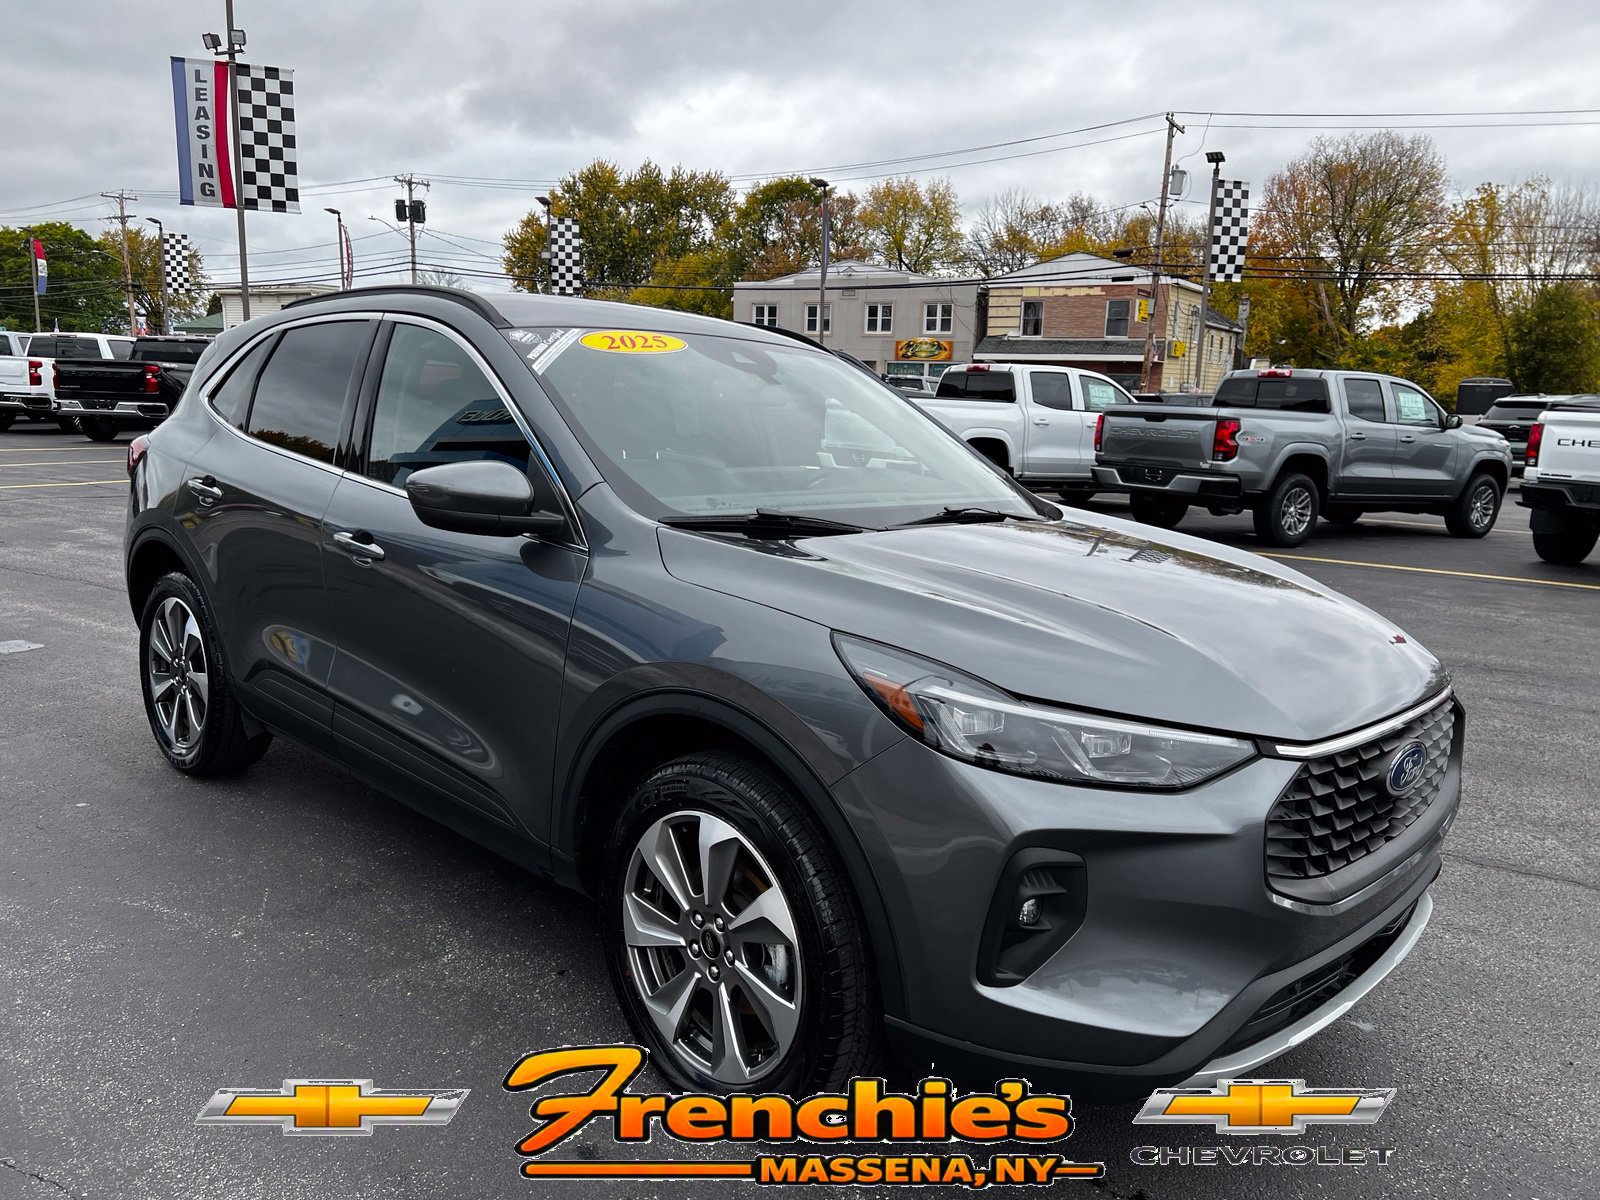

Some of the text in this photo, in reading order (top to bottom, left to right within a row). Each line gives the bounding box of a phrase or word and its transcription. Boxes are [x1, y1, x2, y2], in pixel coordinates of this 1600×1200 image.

[194, 69, 216, 198] LEASING
[601, 334, 668, 350] 2025
[1110, 425, 1200, 440] CHEVROLET
[1400, 753, 1423, 786] Ford
